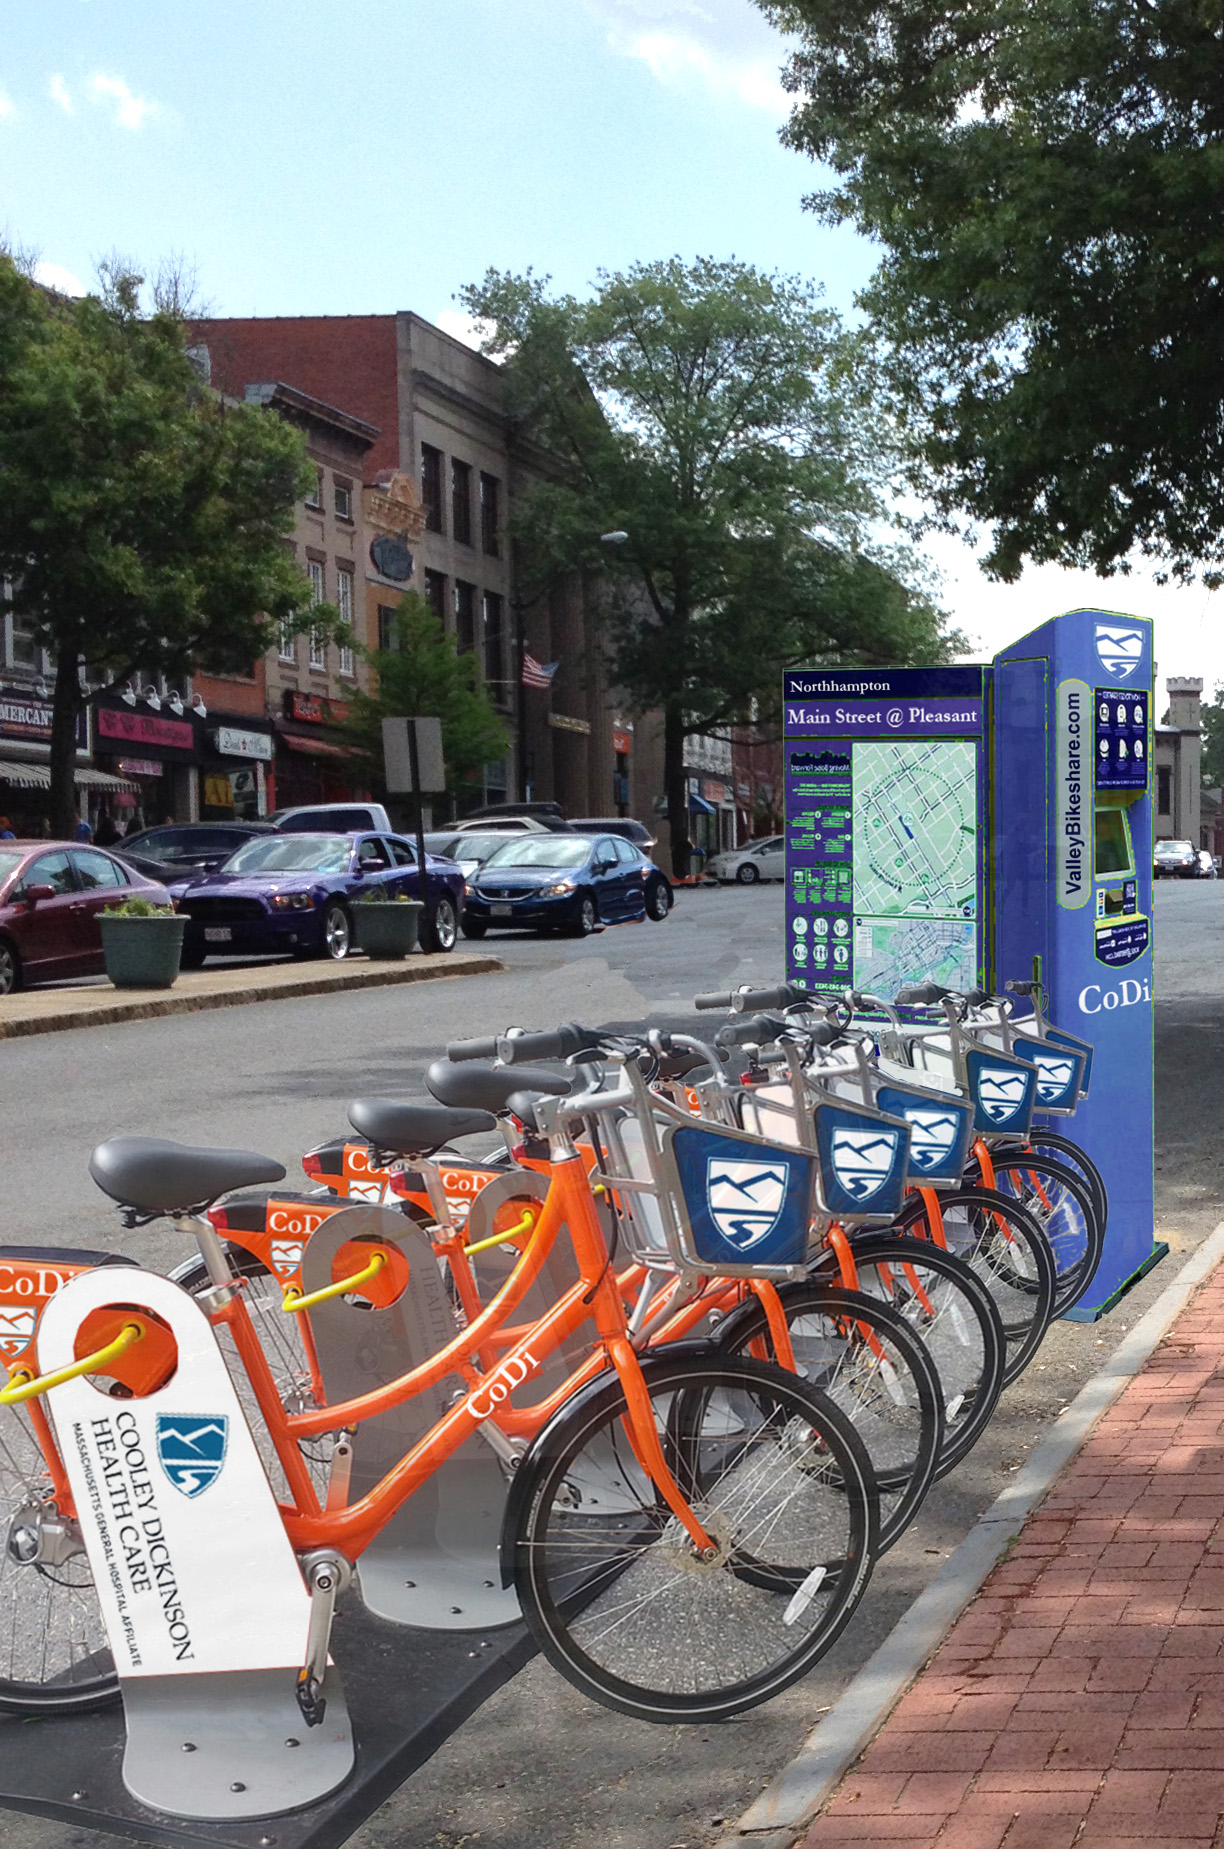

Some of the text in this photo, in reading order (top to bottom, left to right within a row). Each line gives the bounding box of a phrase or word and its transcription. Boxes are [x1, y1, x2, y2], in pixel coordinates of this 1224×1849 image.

[787, 708, 978, 727] Main Street @ Pleasant
[789, 680, 891, 695] Northhampton
[1065, 692, 1085, 895] ValleyBikeshare.com
[1078, 978, 1152, 1014] CoDi
[466, 1346, 541, 1419] CoDi
[73, 1422, 143, 1668] MASSACHUSETTS GENERAL HOSPITAL AFFILIATE
[91, 1417, 152, 1595] HEALTH CARE
[115, 1411, 195, 1661] COOLEY DICKINSON
